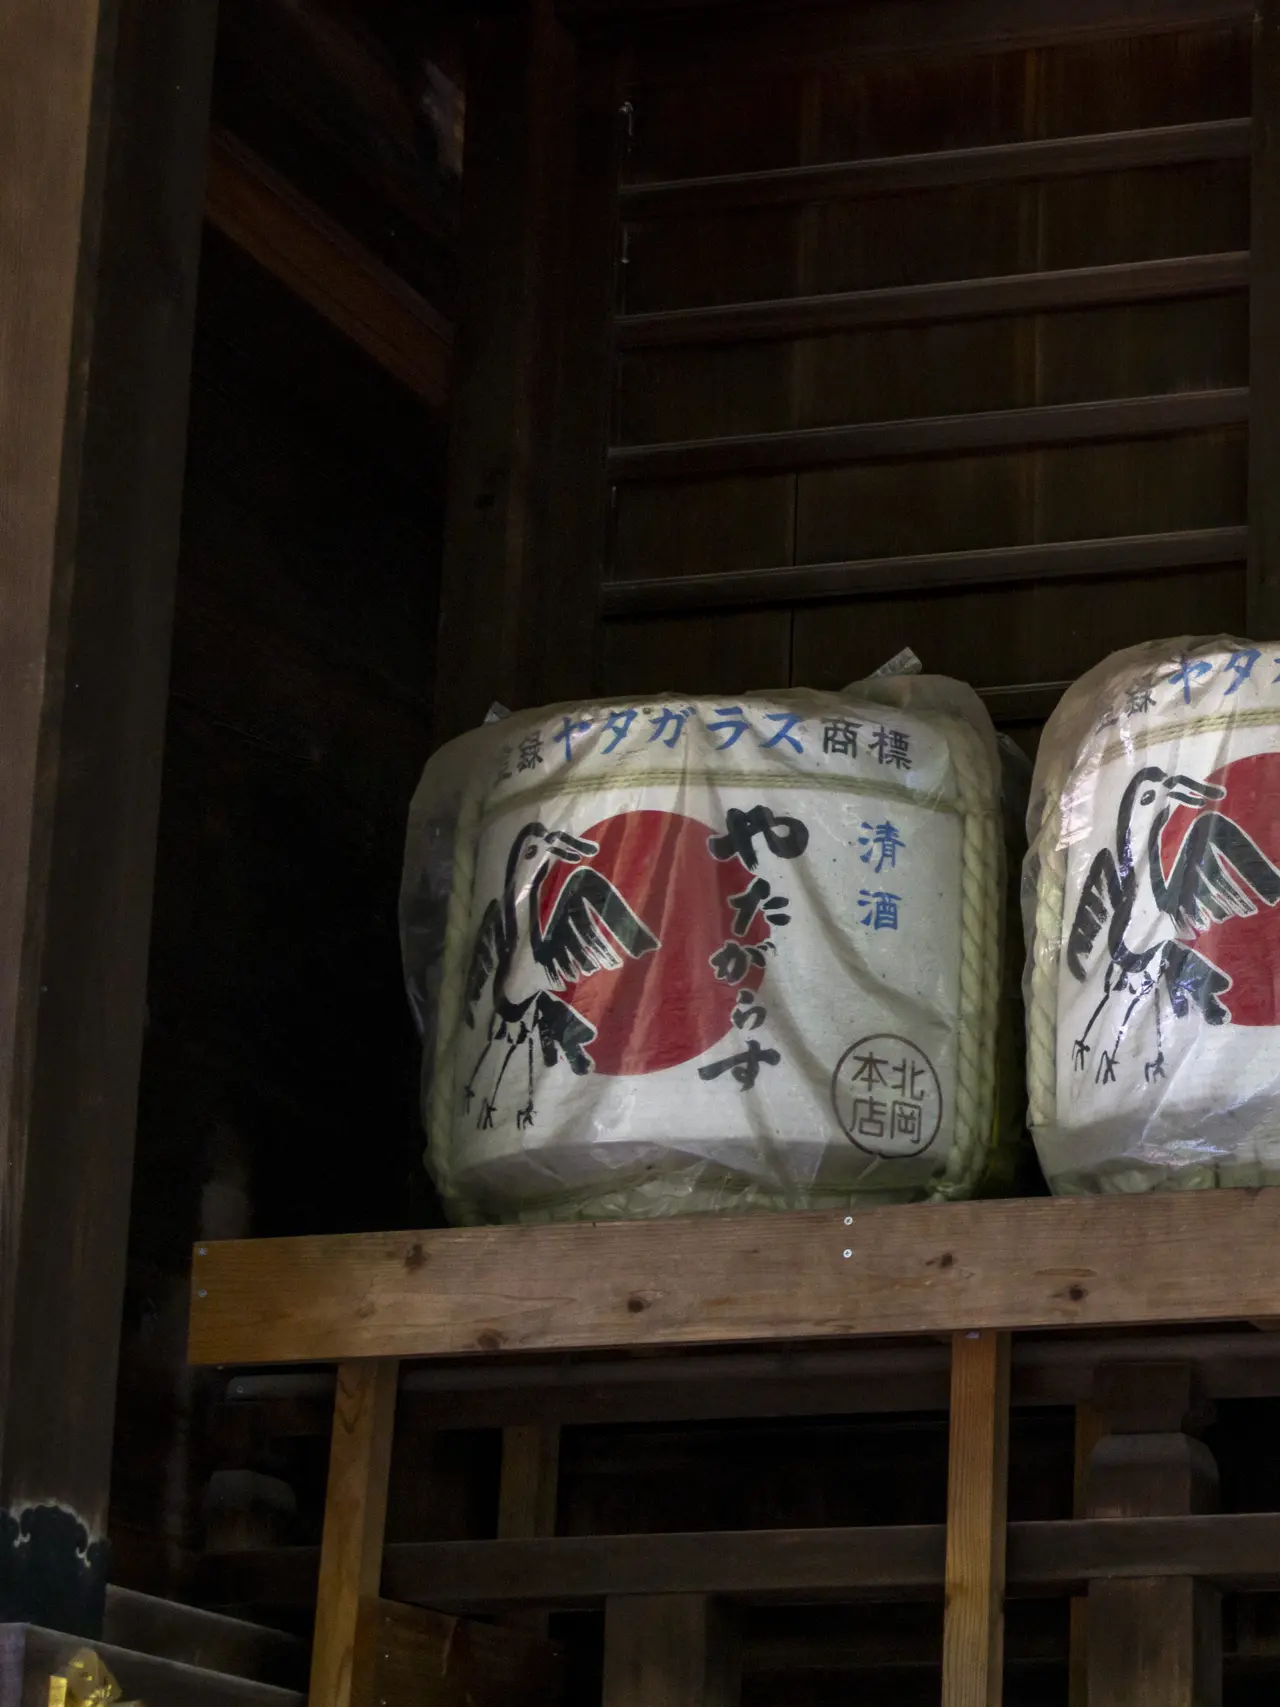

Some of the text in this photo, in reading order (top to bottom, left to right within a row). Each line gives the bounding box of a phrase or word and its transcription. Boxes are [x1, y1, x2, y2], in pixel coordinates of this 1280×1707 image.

[553, 706, 804, 761] ヤタガラス
[820, 717, 913, 770] 商標
[857, 820, 906, 931] 清酒
[697, 805, 809, 1093] やたがらす
